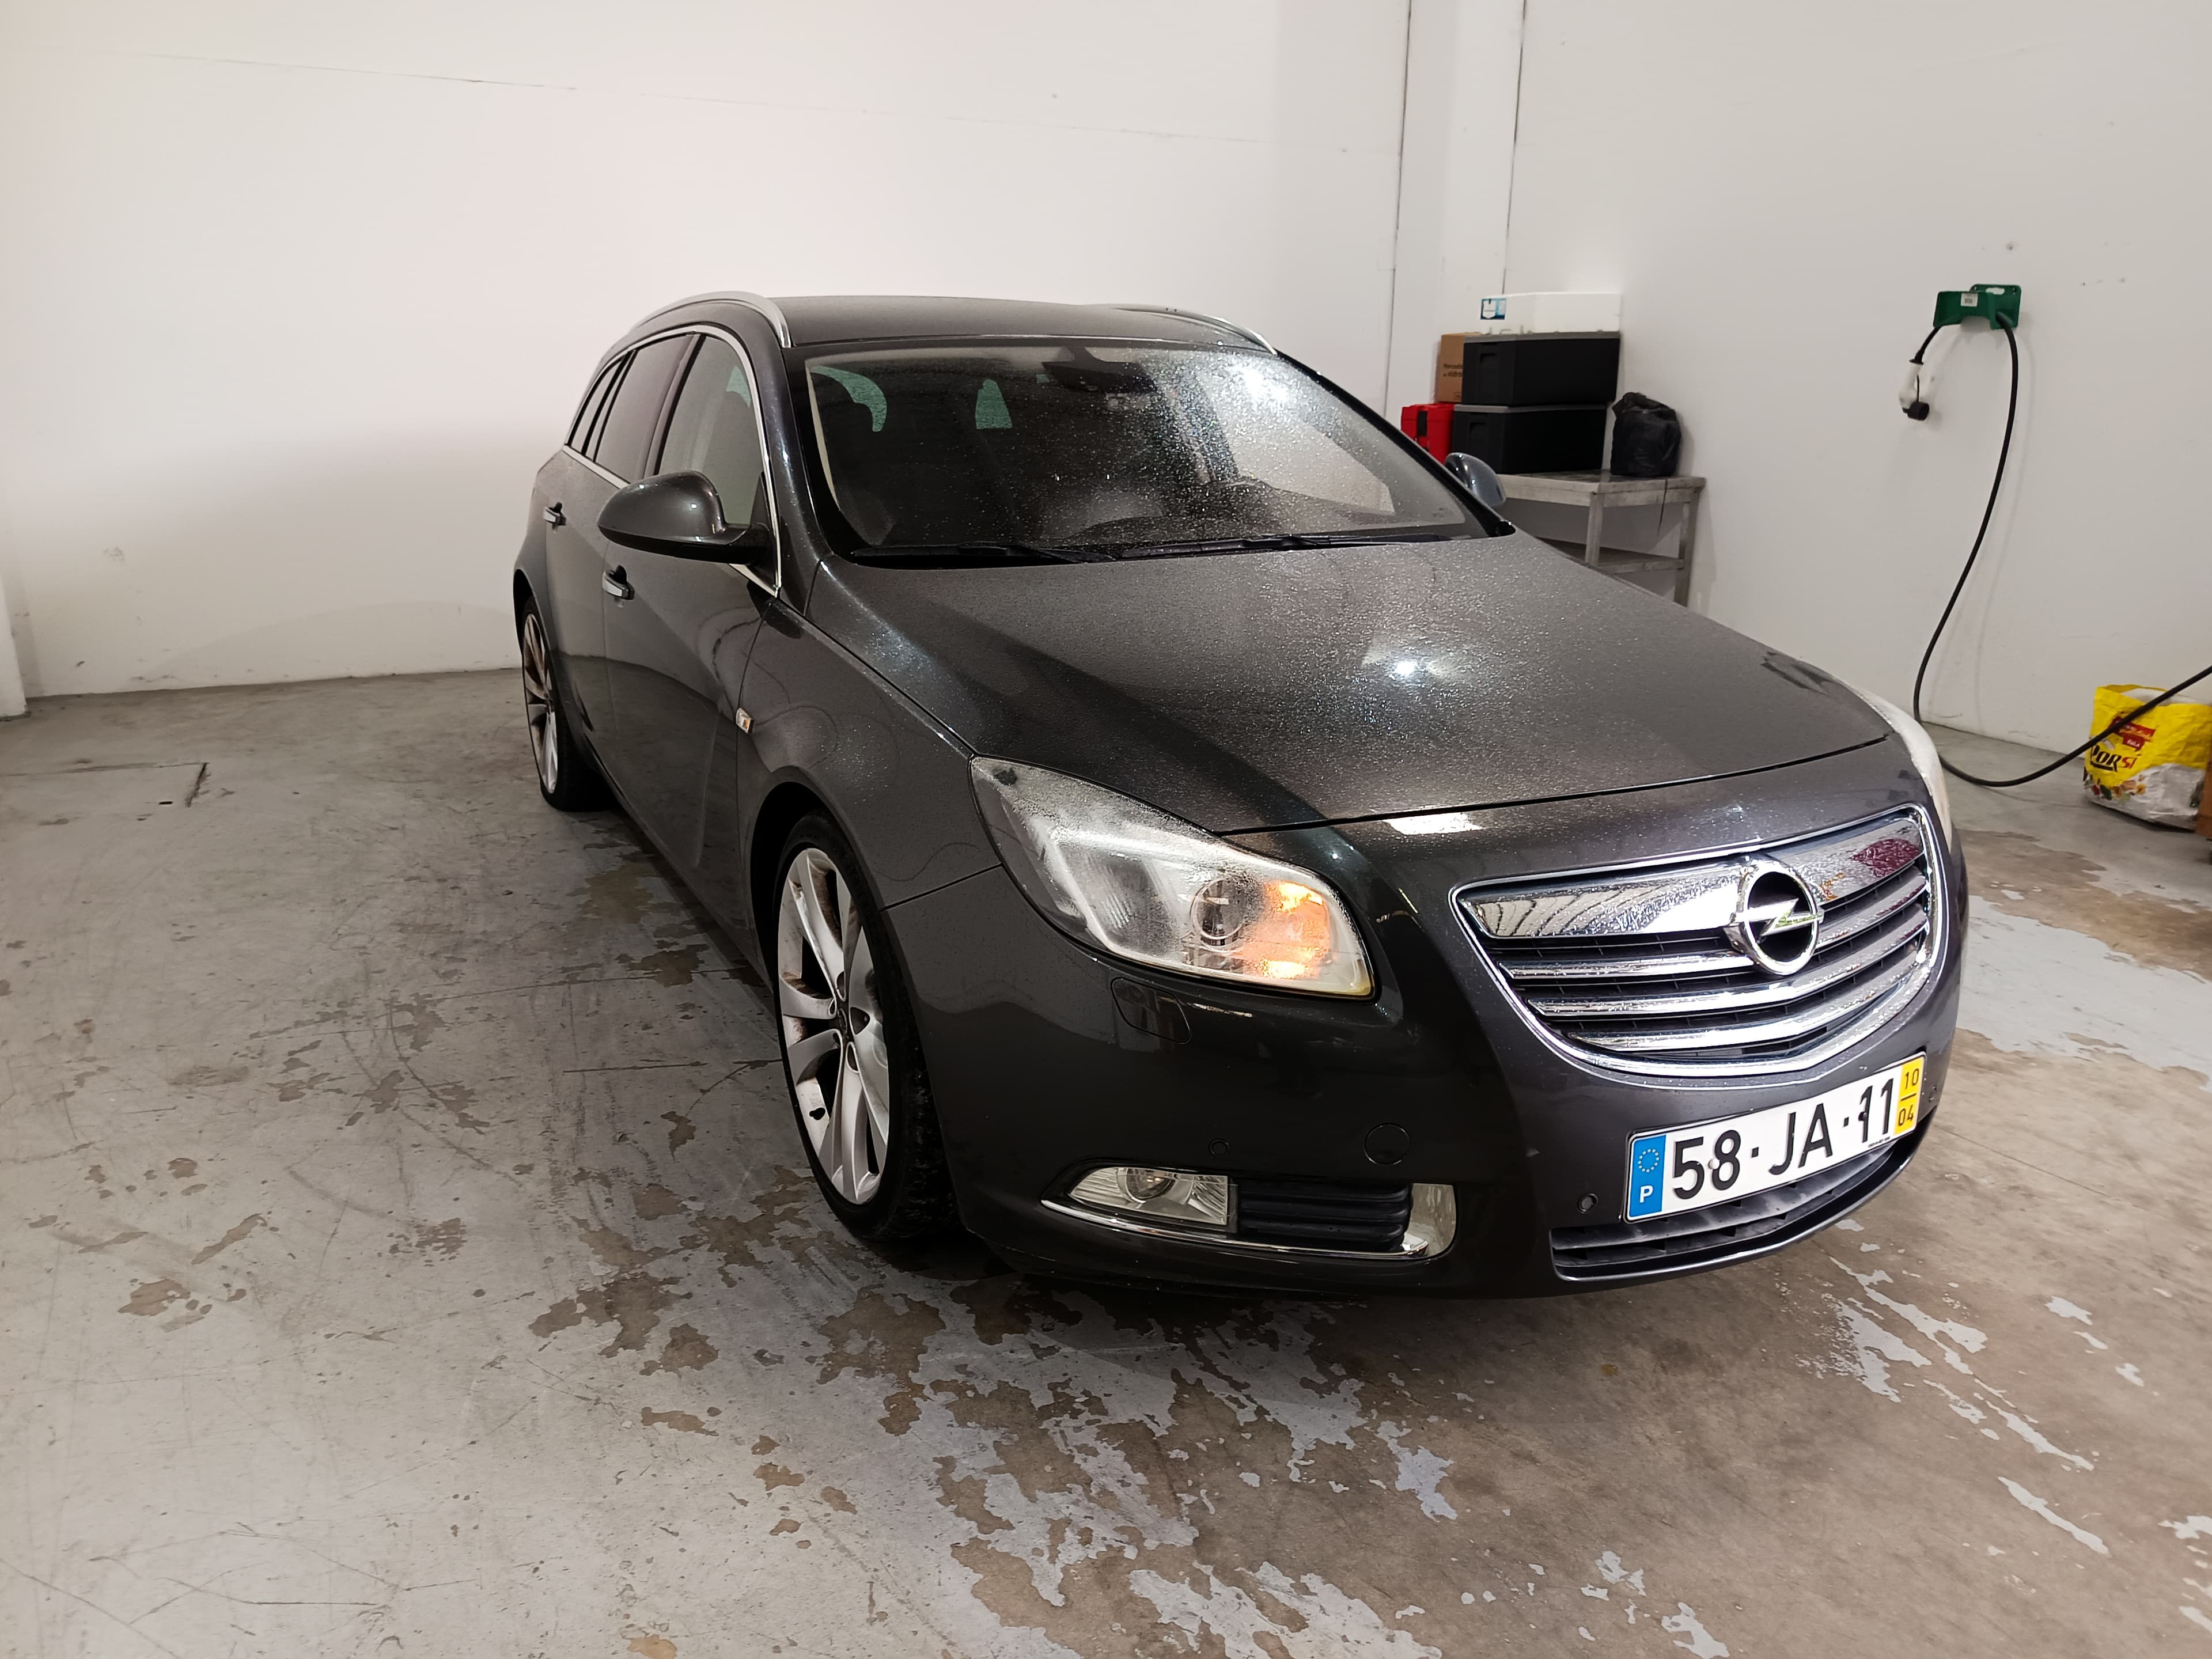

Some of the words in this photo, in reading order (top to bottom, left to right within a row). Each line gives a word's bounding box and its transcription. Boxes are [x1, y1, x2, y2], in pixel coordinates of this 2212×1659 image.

[1905, 1067, 1919, 1090] 10
[1897, 1104, 1914, 1127] 04
[1639, 1185, 1653, 1203] P
